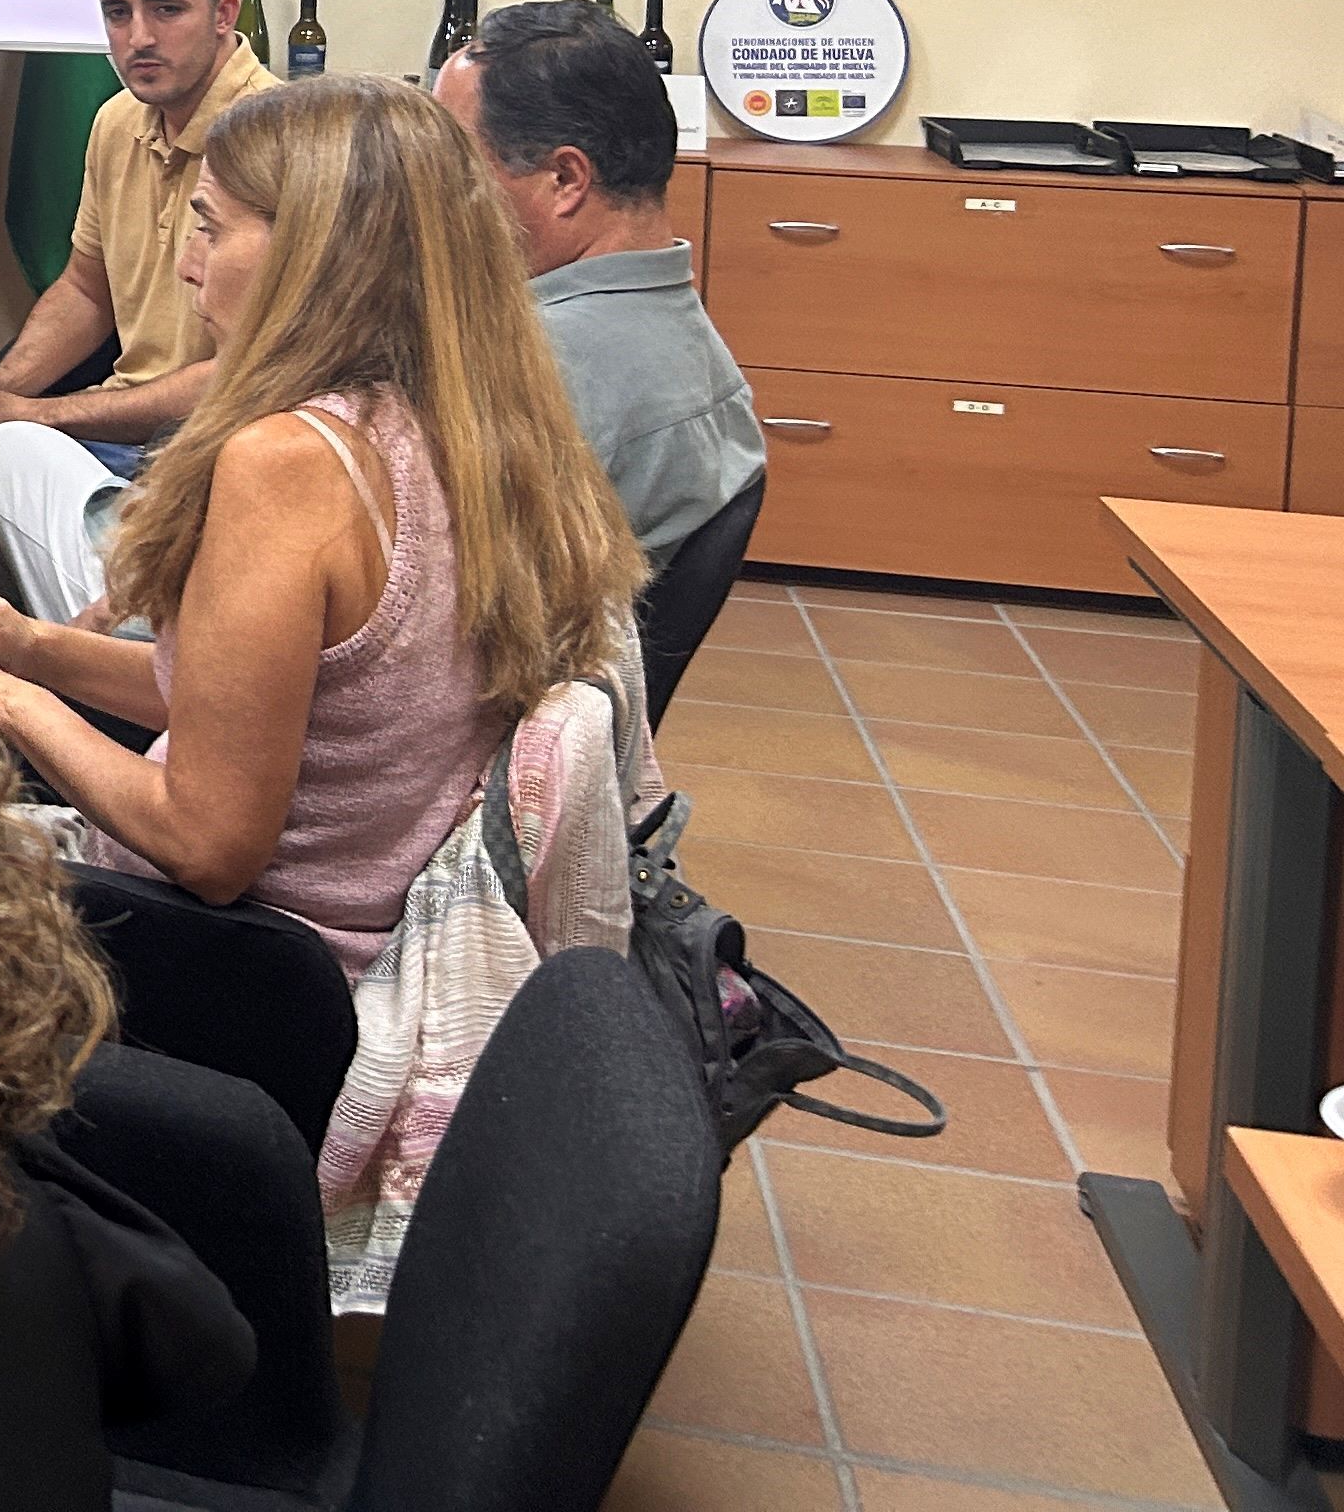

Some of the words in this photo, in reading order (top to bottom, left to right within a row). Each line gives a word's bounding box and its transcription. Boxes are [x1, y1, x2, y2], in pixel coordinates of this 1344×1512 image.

[731, 38, 817, 47] DENOMINACIONES
[821, 38, 833, 47] DE
[838, 38, 875, 47] ORIGEN
[732, 48, 797, 60] CONDADO
[801, 48, 818, 60] DE
[822, 48, 875, 60] HUELVA
